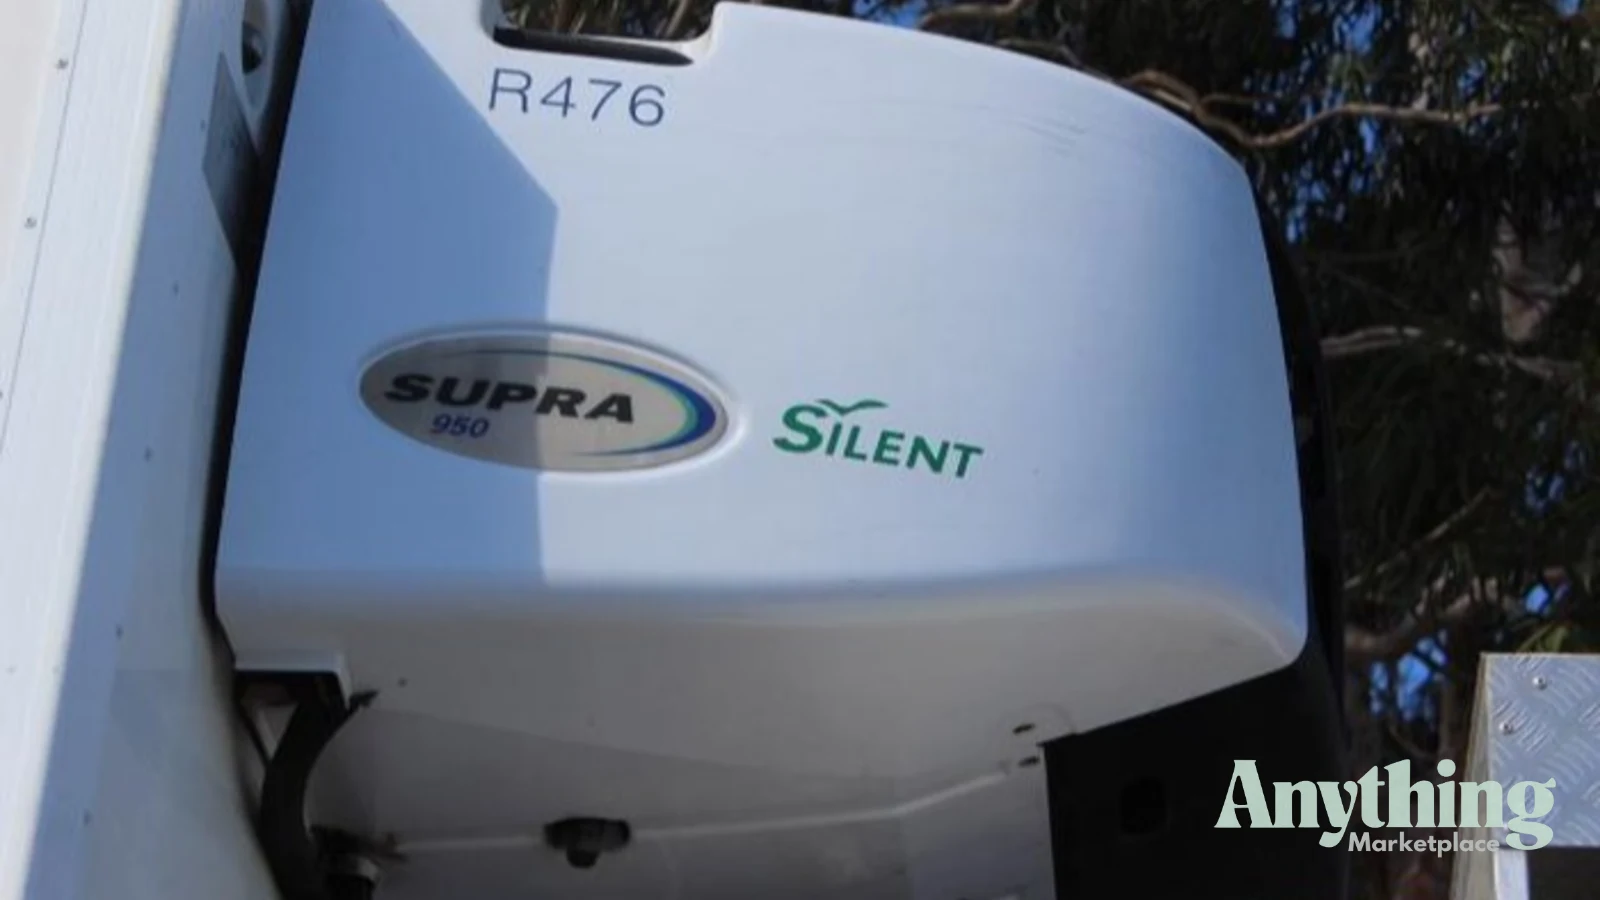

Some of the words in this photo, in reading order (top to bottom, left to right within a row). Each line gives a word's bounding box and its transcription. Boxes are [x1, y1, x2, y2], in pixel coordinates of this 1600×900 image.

[488, 68, 666, 127] R476
[384, 373, 635, 424] SUPRA
[429, 412, 489, 439] 950
